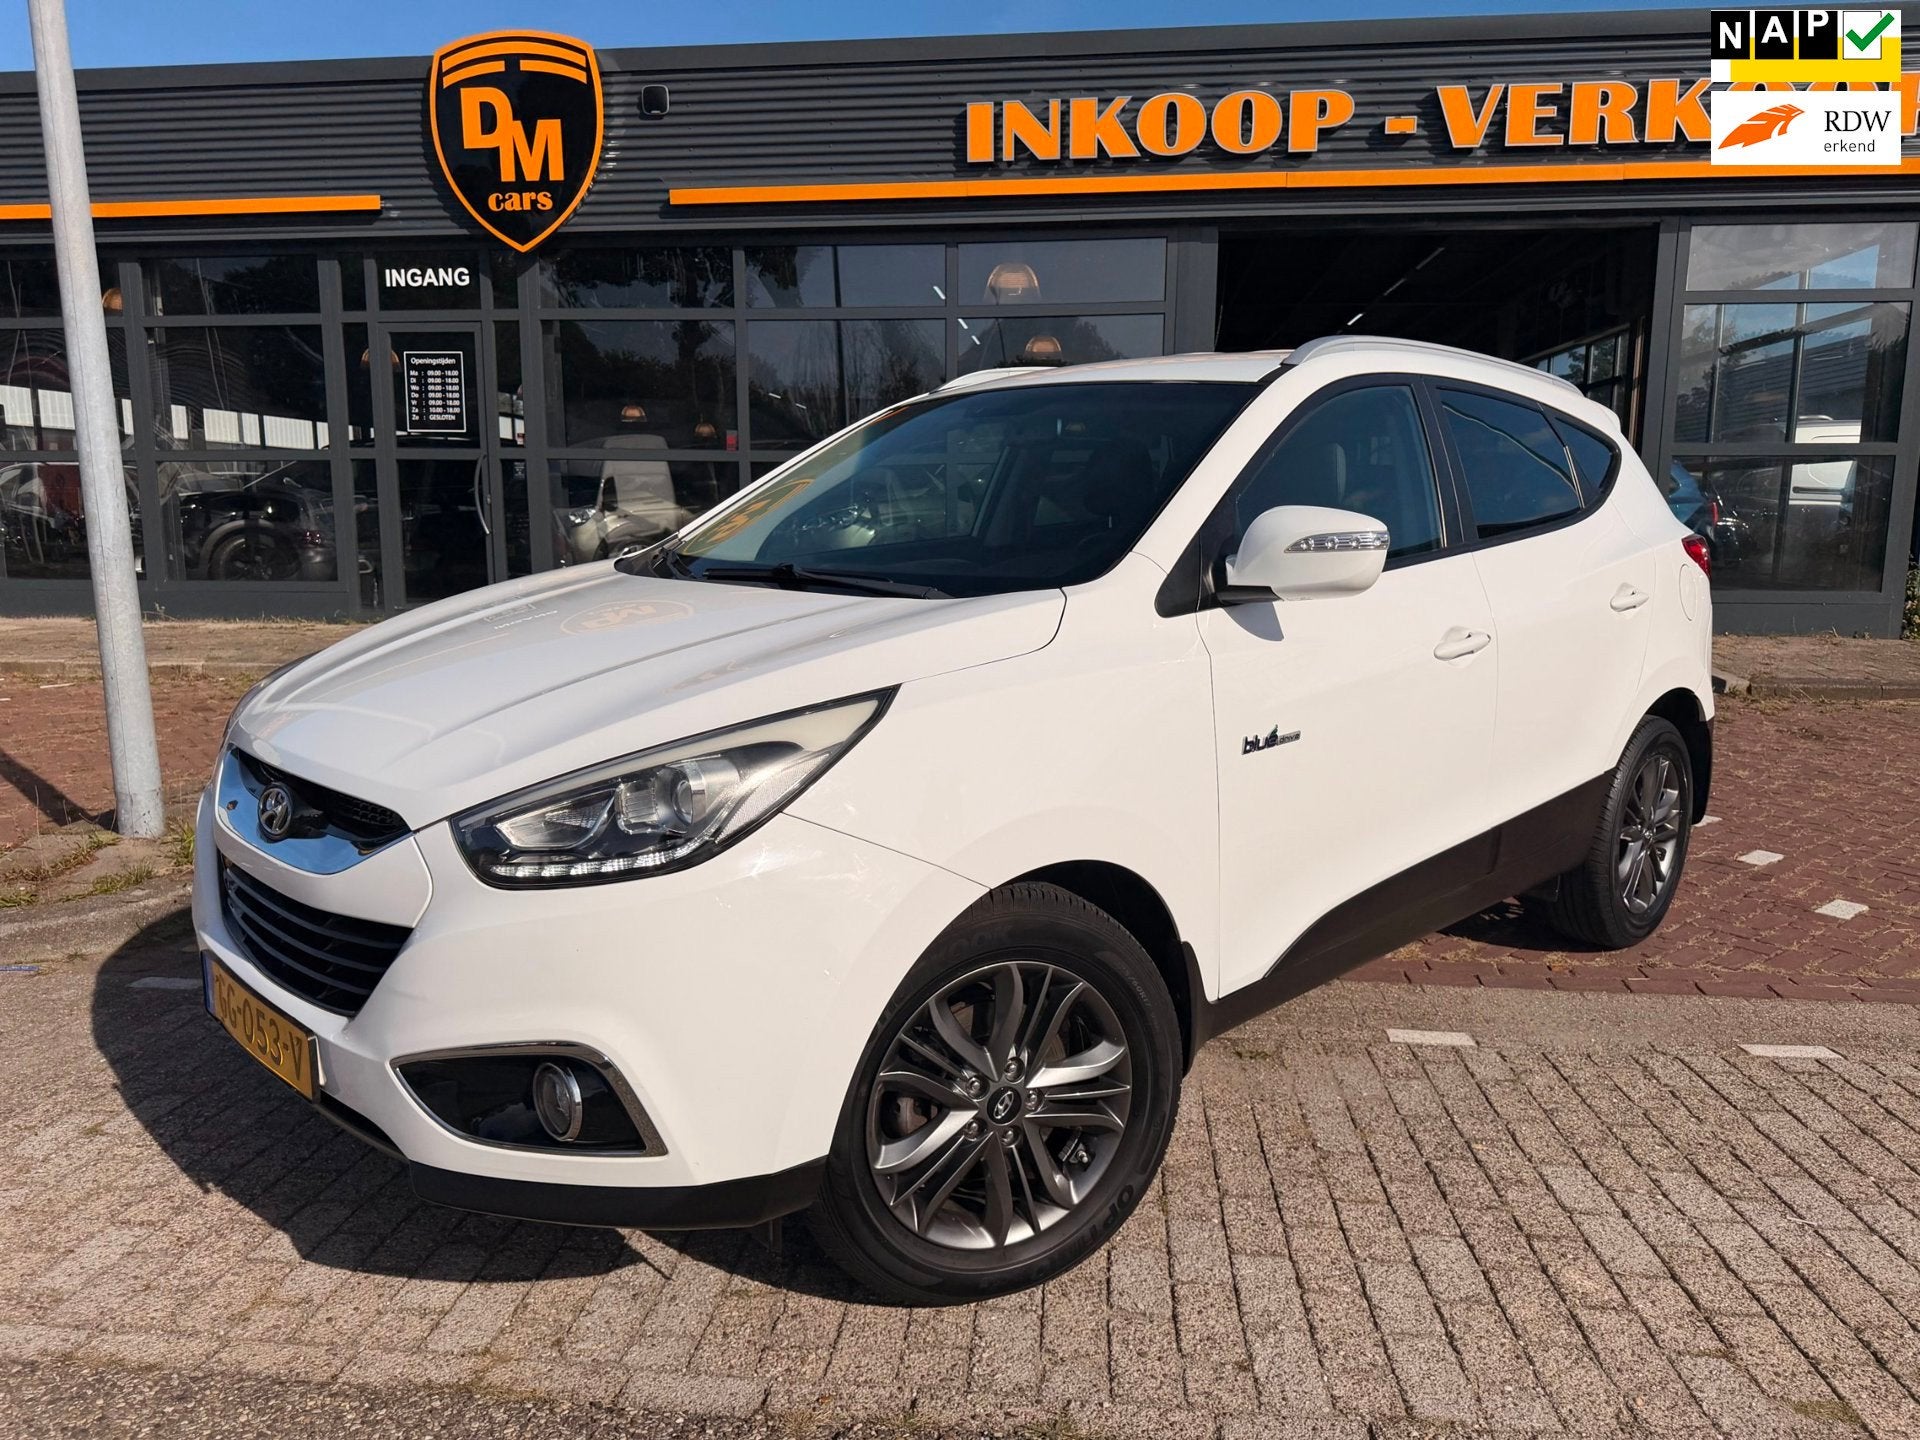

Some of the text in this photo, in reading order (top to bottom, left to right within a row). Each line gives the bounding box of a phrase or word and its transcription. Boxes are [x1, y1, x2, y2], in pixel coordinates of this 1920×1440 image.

[460, 86, 565, 182] DM
[966, 89, 1355, 163] INKOOP
[1436, 71, 1920, 149] VERK
[487, 190, 554, 212] cars
[385, 267, 470, 288] INGANG
[410, 357, 456, 365] Openingstijden
[215, 974, 303, 1081] GG-053-V
